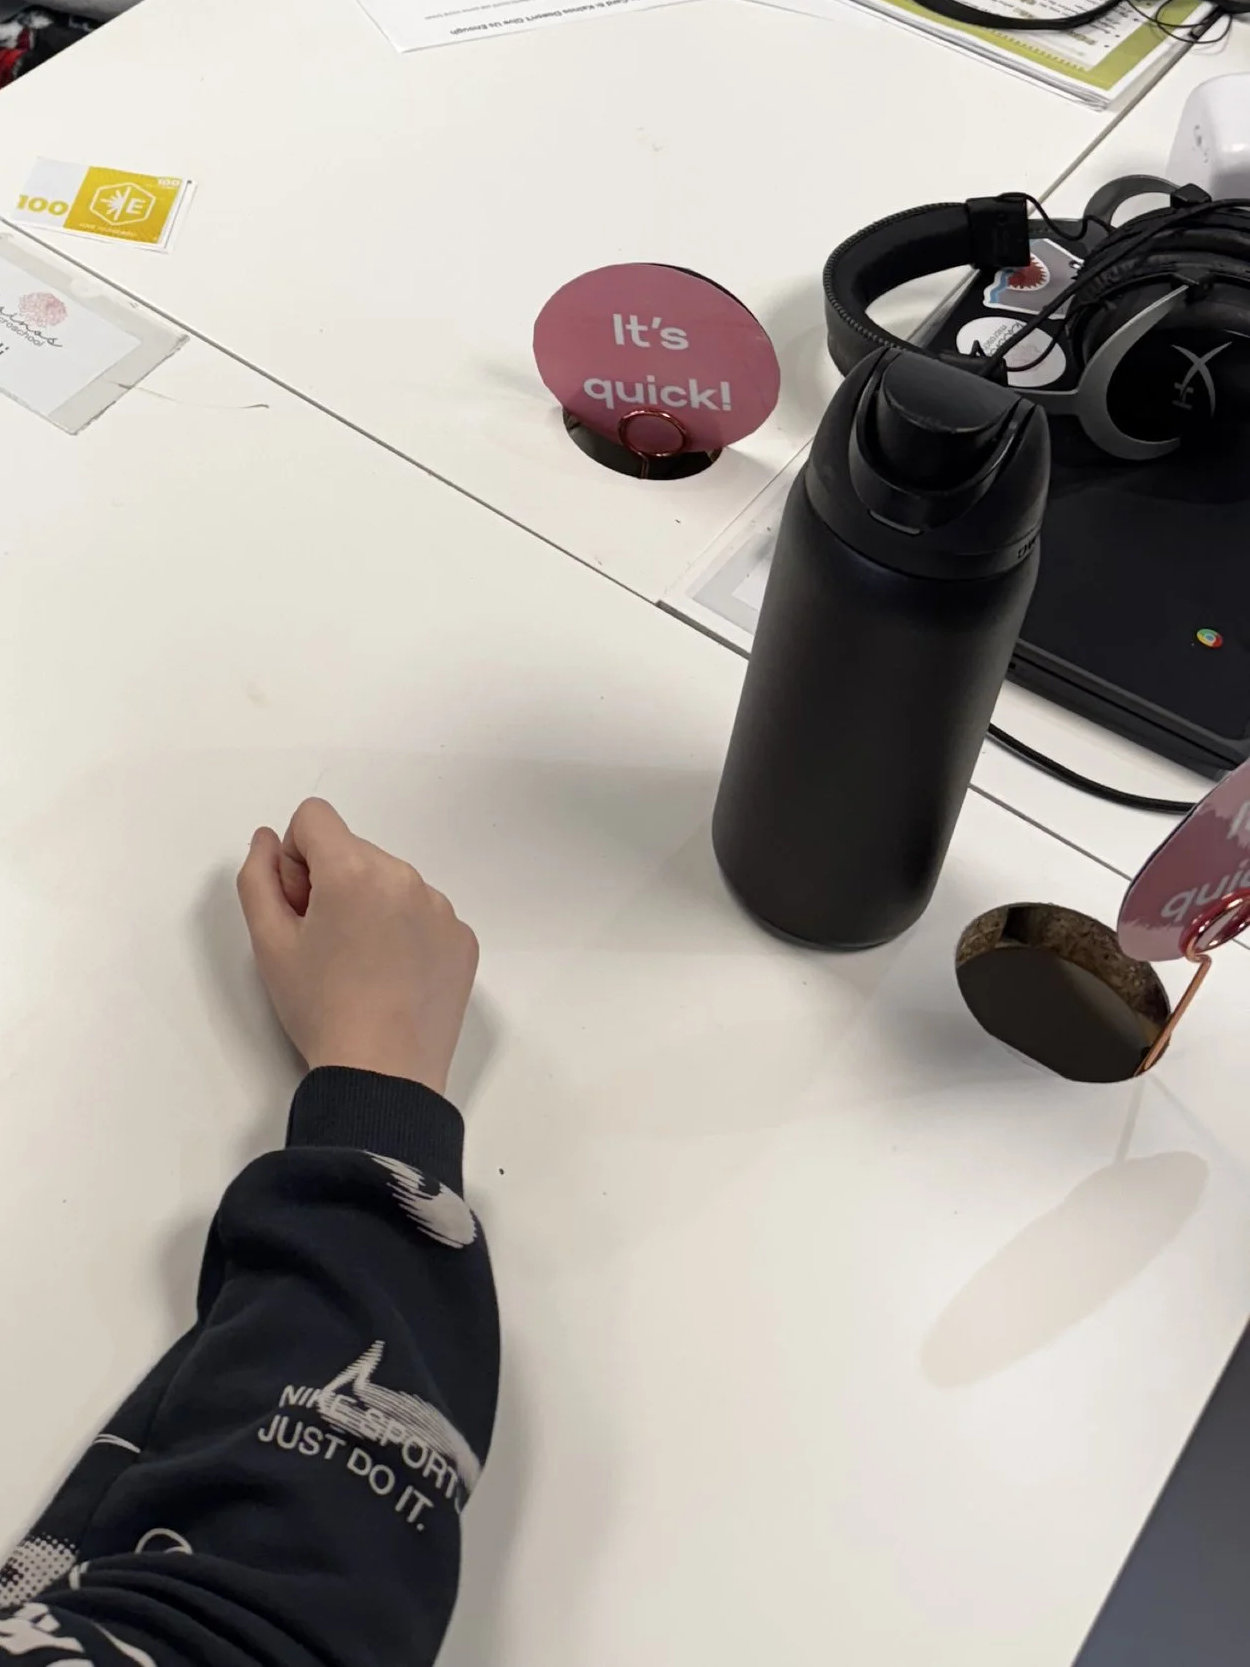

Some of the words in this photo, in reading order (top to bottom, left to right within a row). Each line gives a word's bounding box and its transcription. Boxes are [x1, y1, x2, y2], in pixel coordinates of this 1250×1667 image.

[17, 194, 69, 216] 100
[613, 313, 689, 351] It's
[583, 374, 732, 411] quick!
[257, 1414, 347, 1460] JUST
[346, 1446, 396, 1496] DO
[394, 1485, 435, 1532] IT.
